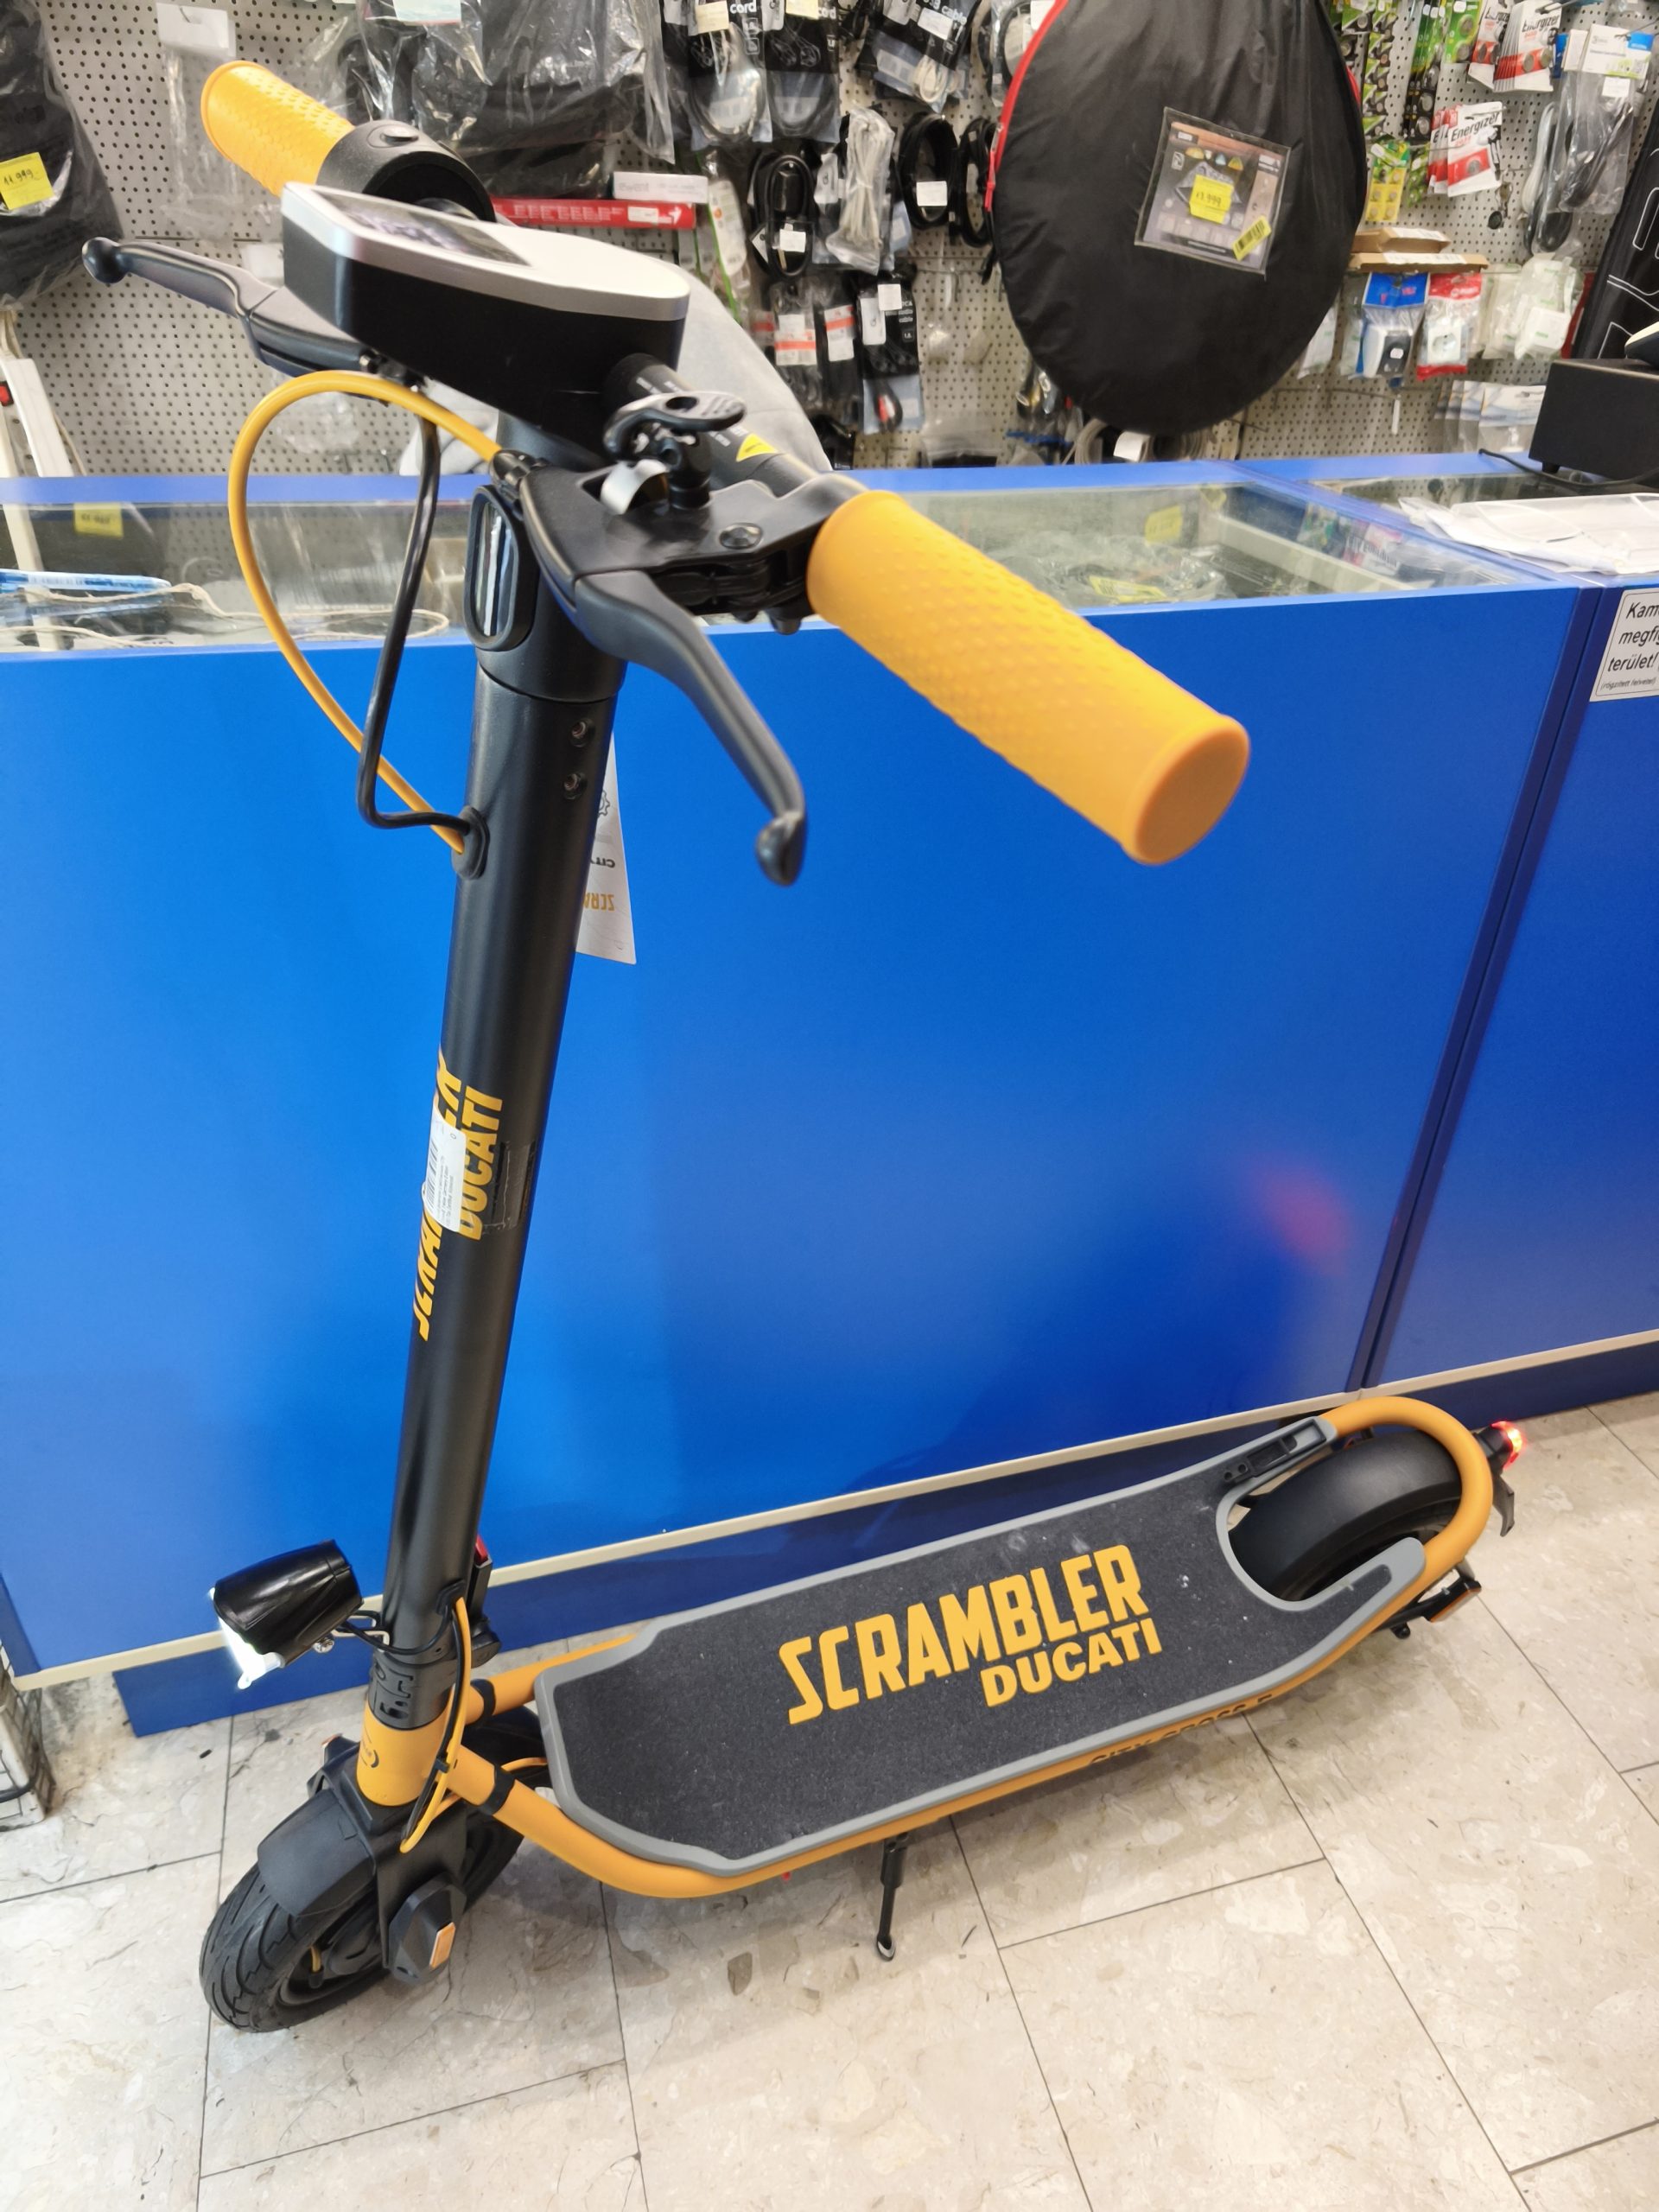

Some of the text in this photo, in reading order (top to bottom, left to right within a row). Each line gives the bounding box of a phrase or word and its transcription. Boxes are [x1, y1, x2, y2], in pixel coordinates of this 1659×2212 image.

[729, 0, 757, 14] cord
[1451, 111, 1499, 142] Energizer
[1626, 602, 1659, 619] Kam
[1607, 652, 1659, 672] terület!
[458, 1085, 503, 1241] DUCATI
[779, 1544, 1149, 1725] SCRAMBLER
[980, 1618, 1163, 1707] DUCATI
